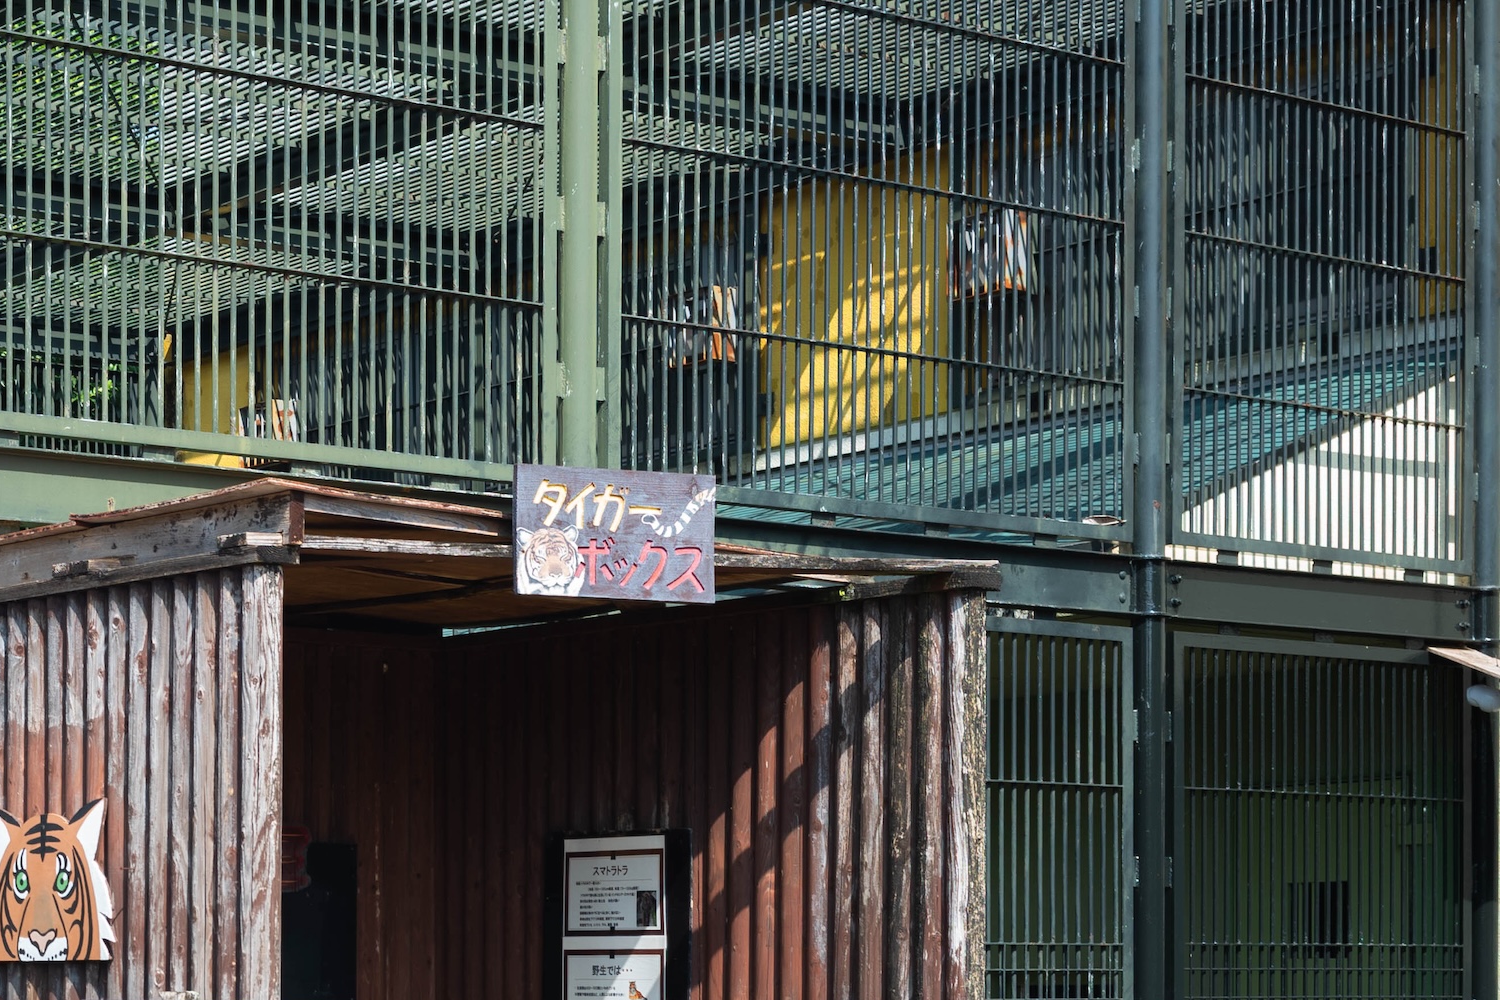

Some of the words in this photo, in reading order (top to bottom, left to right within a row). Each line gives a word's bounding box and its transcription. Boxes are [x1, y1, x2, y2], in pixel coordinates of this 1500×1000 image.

[533, 478, 662, 533] タイガー
[574, 537, 705, 593] ボックス
[592, 865, 628, 876] スマトラトラ
